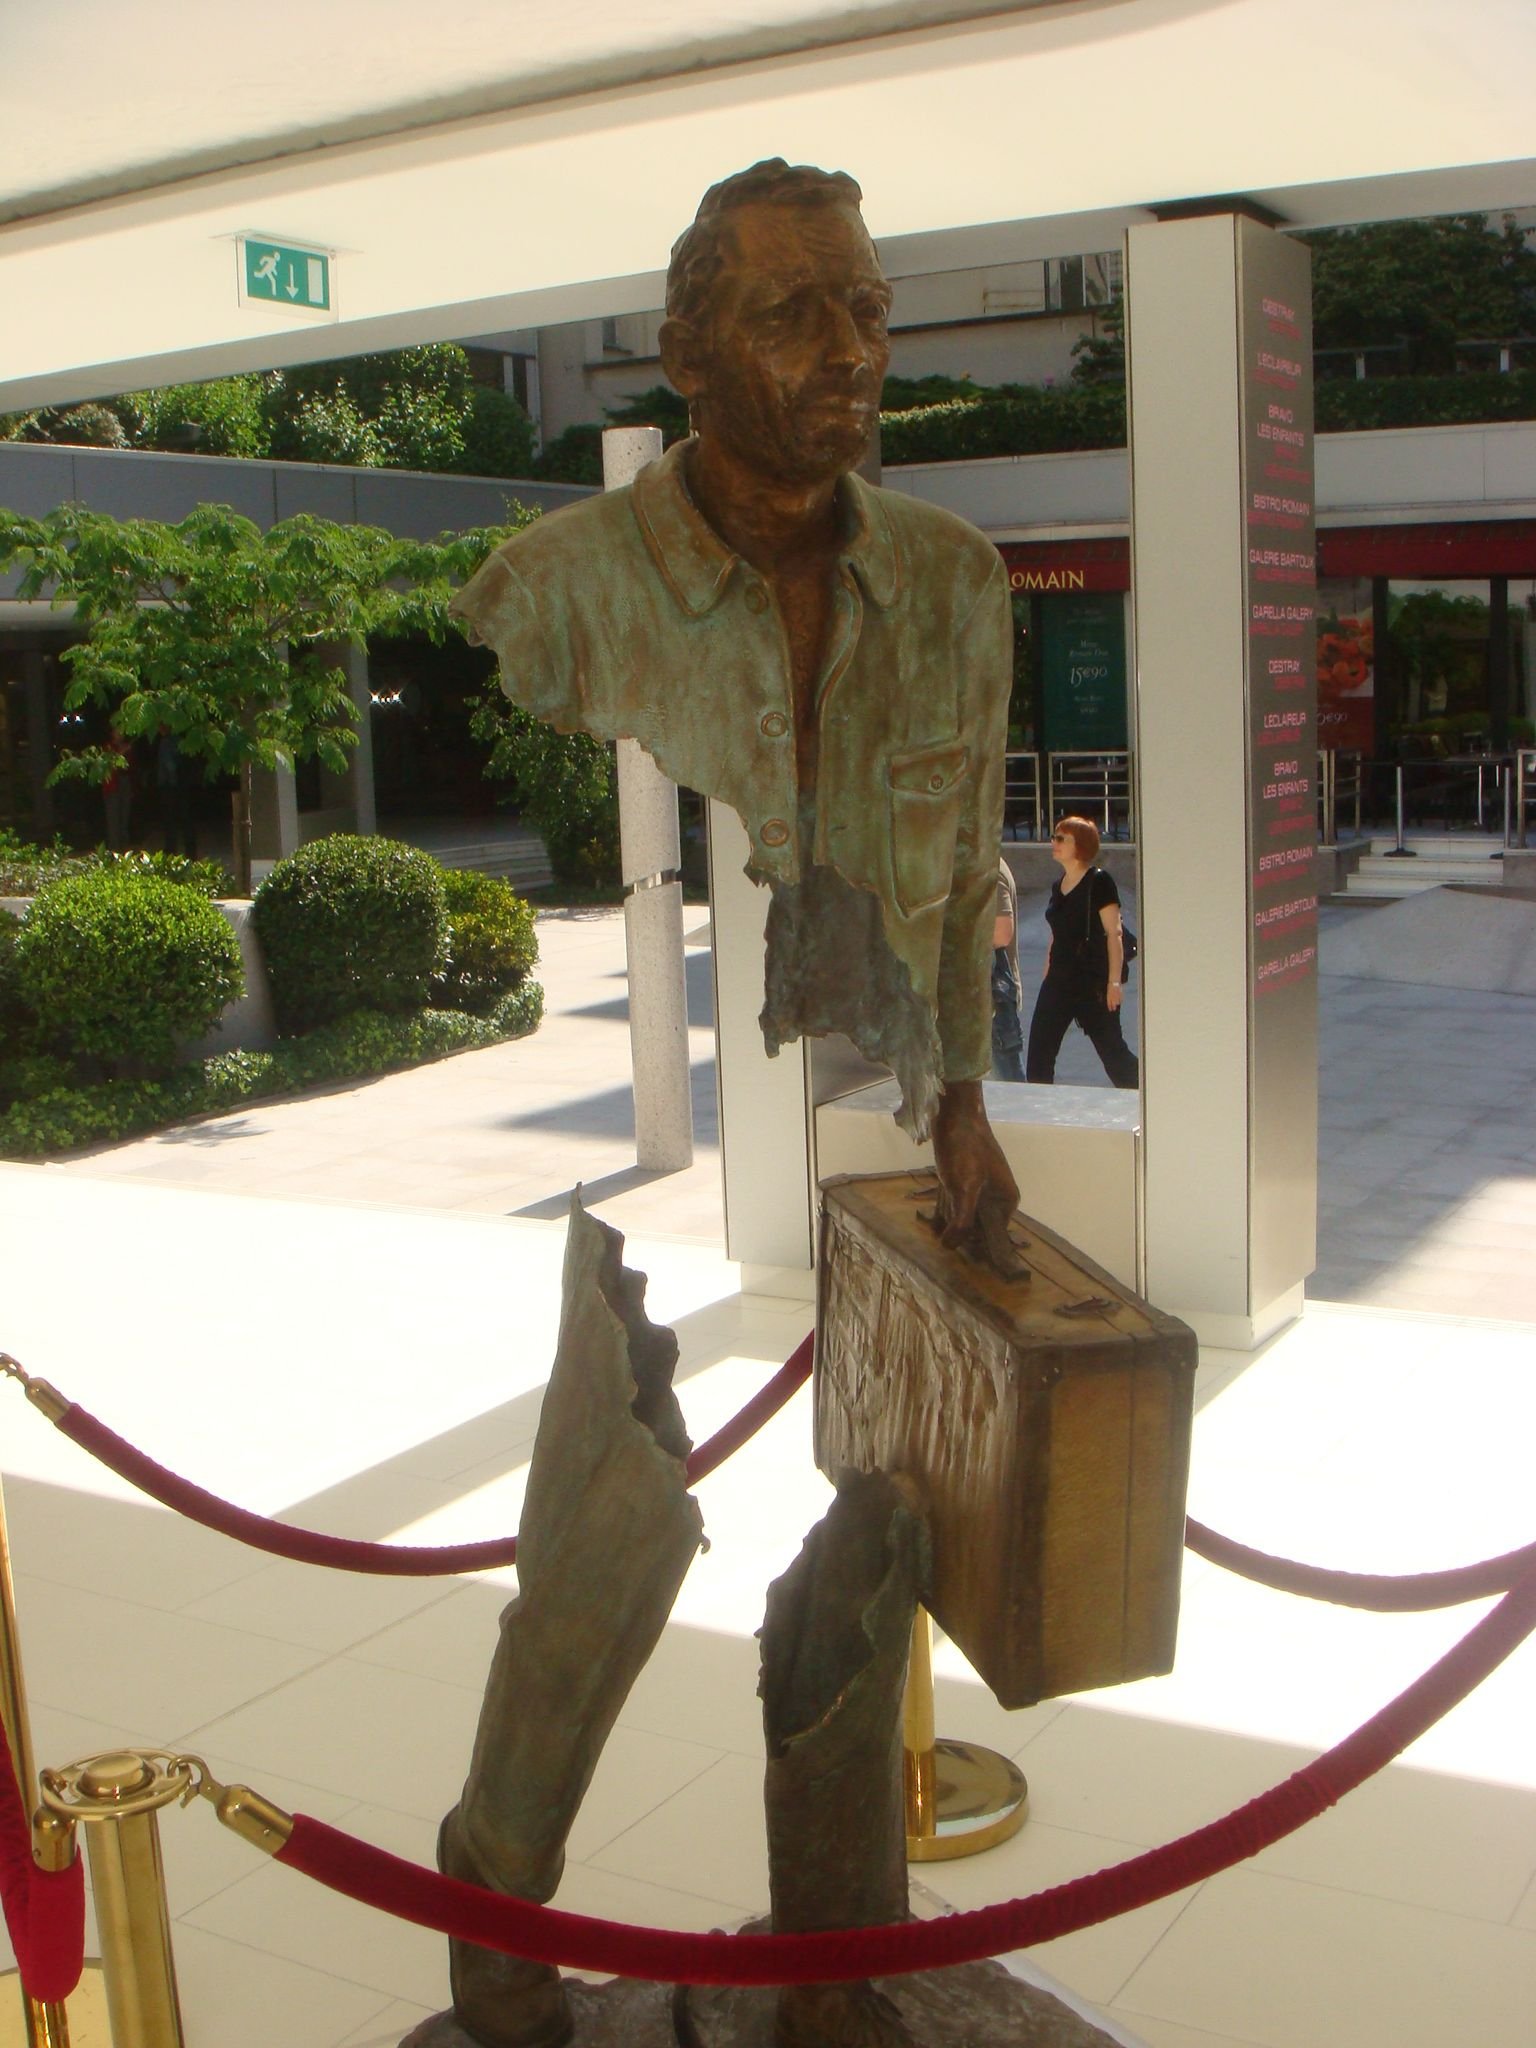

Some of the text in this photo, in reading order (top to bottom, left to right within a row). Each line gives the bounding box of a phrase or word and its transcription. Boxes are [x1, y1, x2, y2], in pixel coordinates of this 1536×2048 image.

[1257, 423, 1272, 439] LES
[1009, 570, 1085, 591] OMAIN
[1274, 760, 1298, 777] BRAVO
[1263, 783, 1278, 799] LES
[1259, 851, 1286, 871] BISTRO
